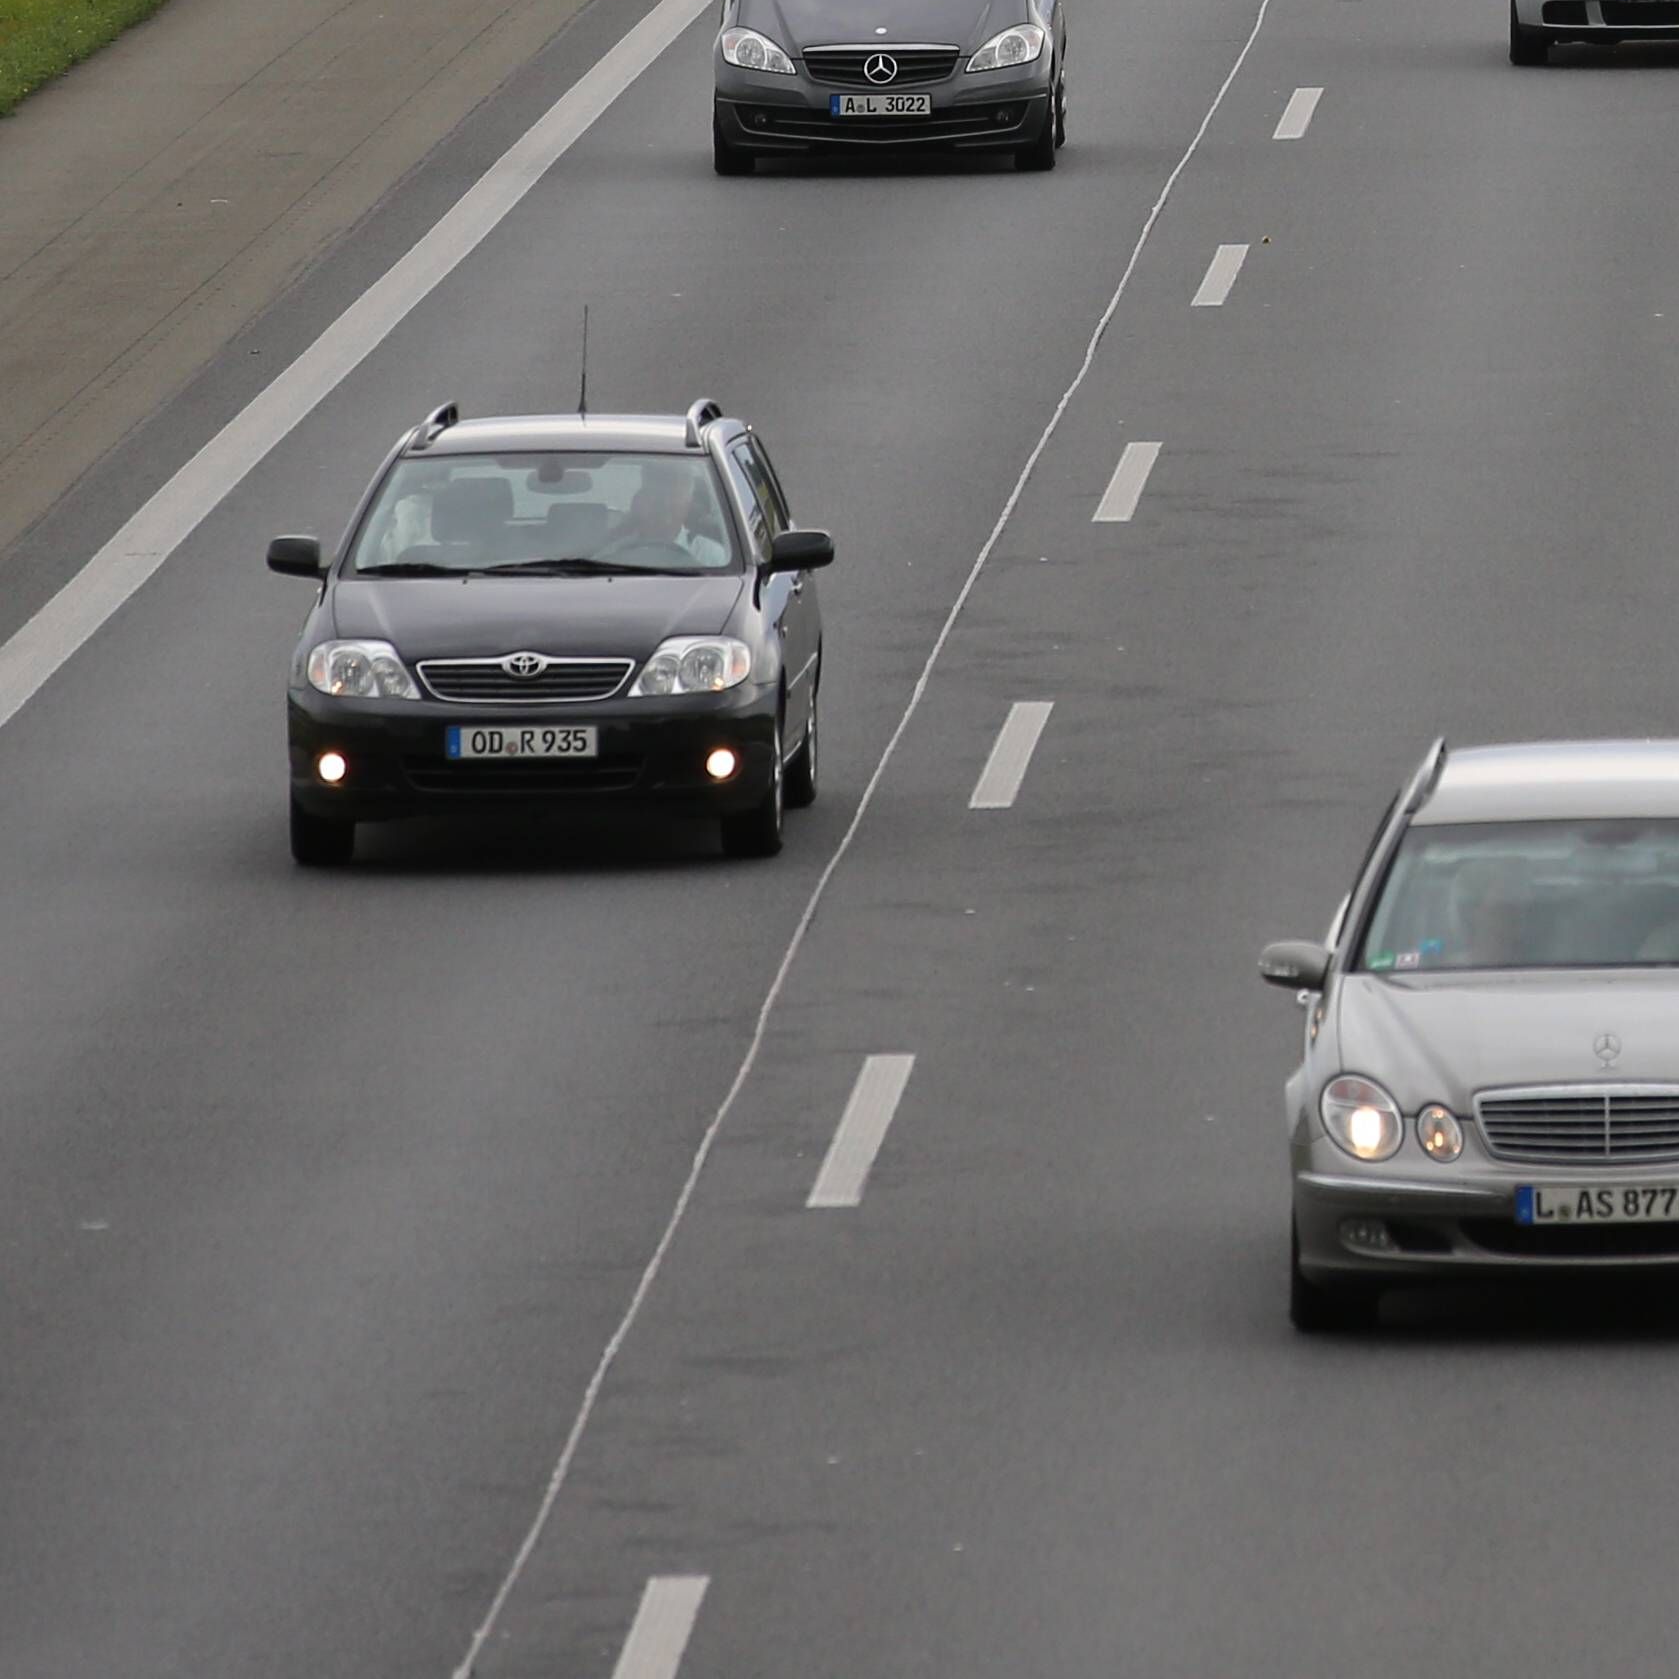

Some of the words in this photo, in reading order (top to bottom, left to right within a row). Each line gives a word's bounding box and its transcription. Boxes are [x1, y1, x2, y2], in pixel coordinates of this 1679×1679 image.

[845, 98, 856, 112] A
[867, 98, 877, 112] L
[886, 97, 926, 112] 3022
[472, 730, 504, 754] OD
[520, 730, 535, 753] R
[543, 729, 588, 753] 935
[1536, 1191, 1555, 1220] L
[1577, 1190, 1614, 1219] AS
